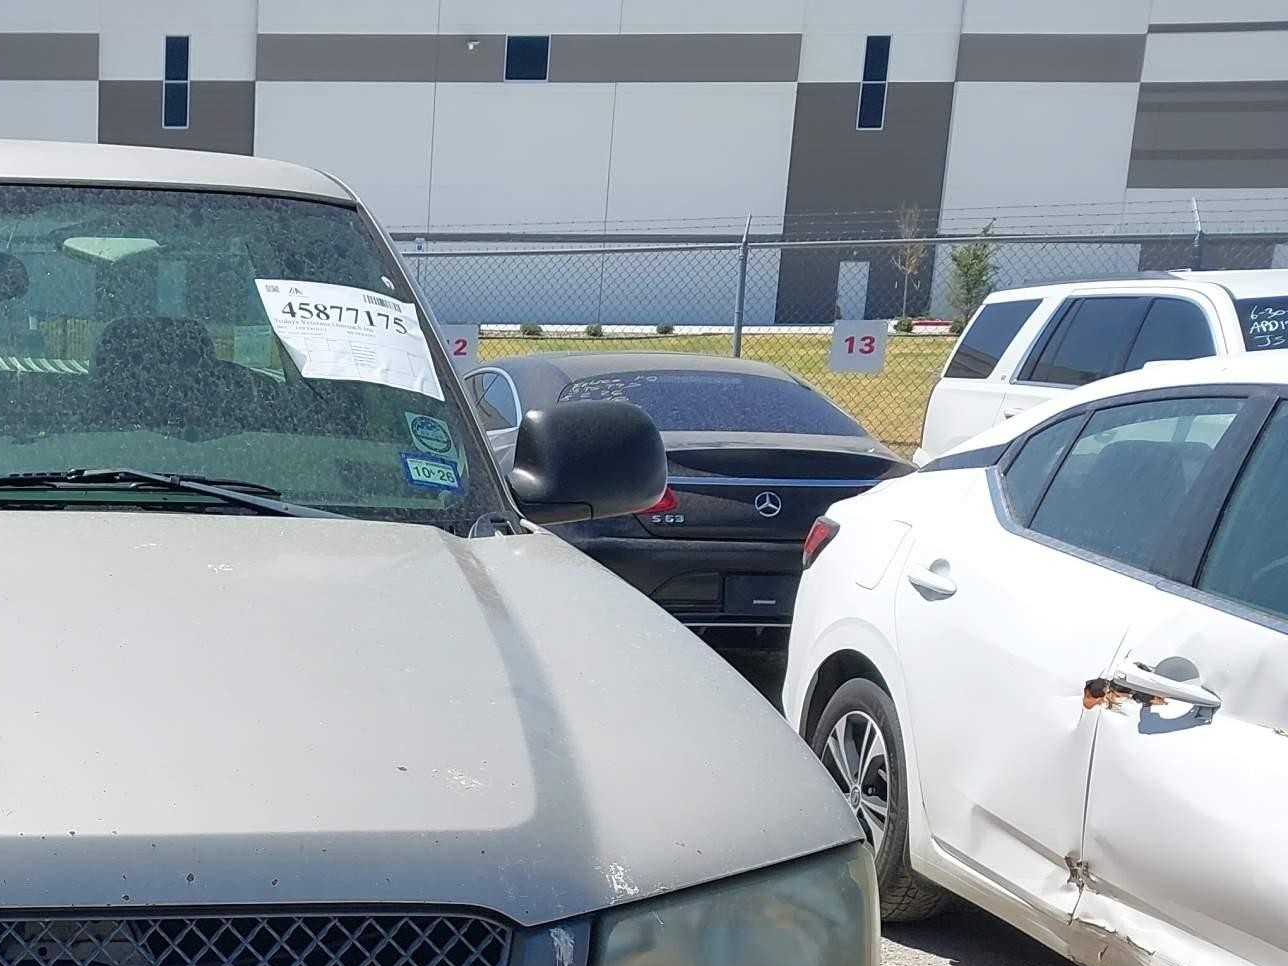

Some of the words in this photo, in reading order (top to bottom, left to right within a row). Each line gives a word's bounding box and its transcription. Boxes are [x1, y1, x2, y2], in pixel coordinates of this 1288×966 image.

[281, 301, 408, 335] 45877175
[844, 335, 876, 354] 13
[412, 466, 431, 479] 10
[437, 469, 456, 484] 26
[652, 514, 662, 523] S
[664, 514, 685, 523] 63
